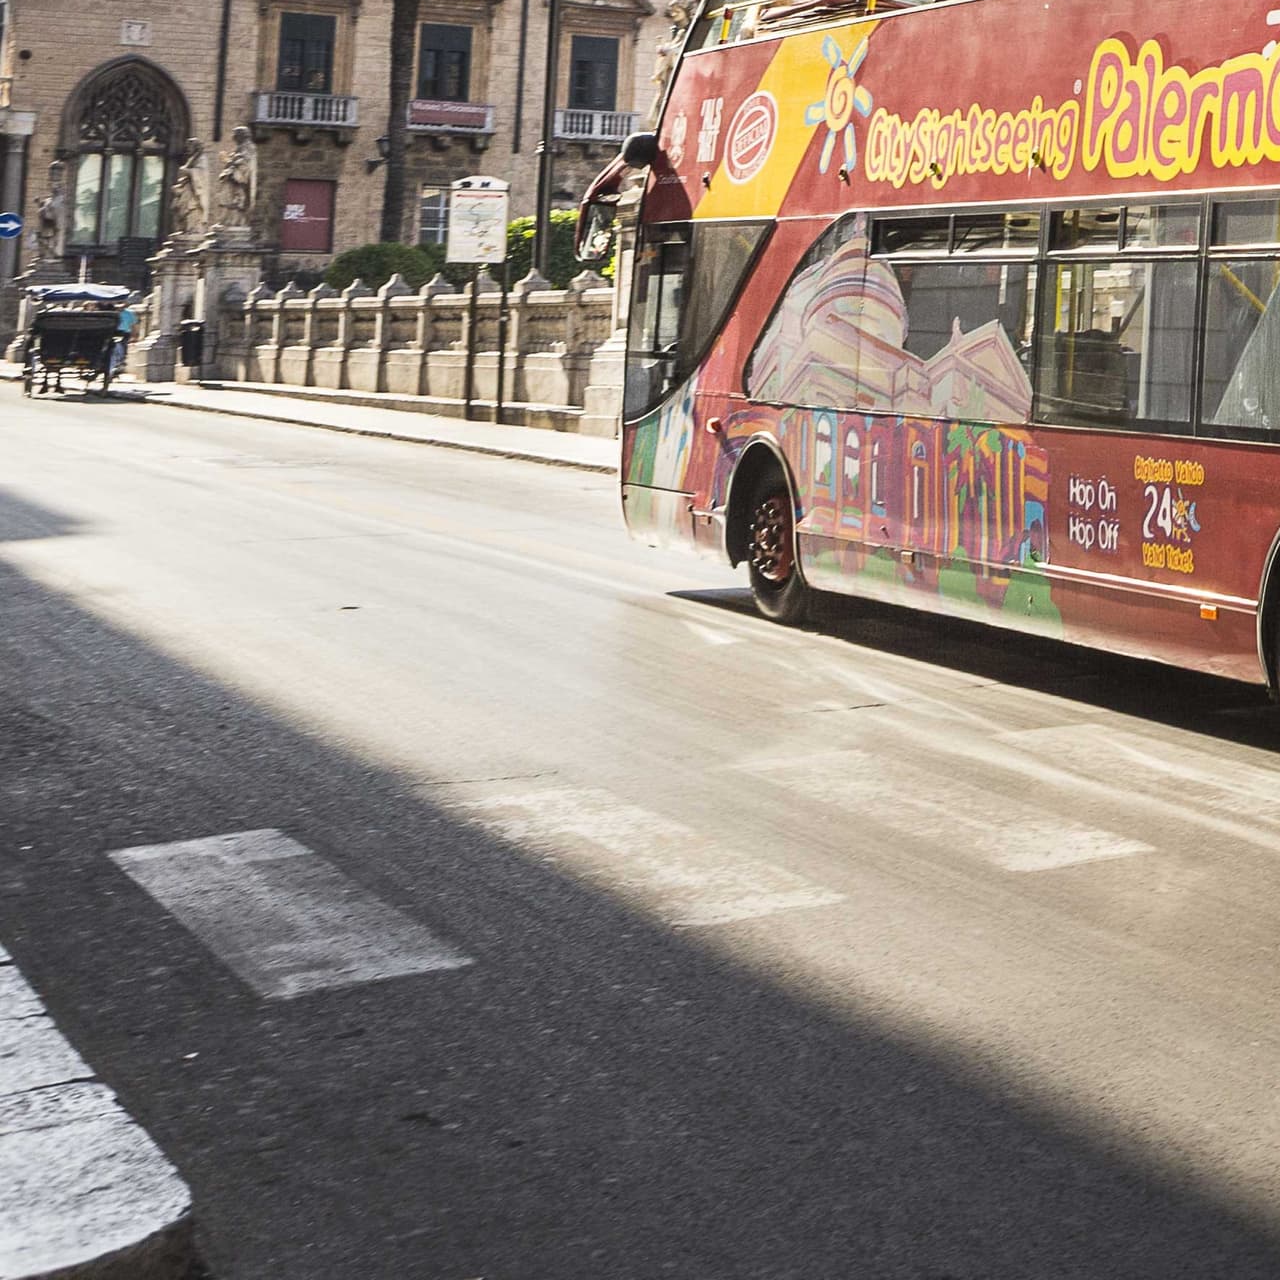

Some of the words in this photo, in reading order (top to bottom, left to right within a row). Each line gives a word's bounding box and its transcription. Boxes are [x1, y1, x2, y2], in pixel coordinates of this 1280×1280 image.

[1069, 477, 1096, 511] Hop
[1098, 477, 1117, 512] On
[1143, 485, 1172, 538] 24
[1069, 516, 1096, 551] Hop
[1098, 518, 1120, 551] Off
